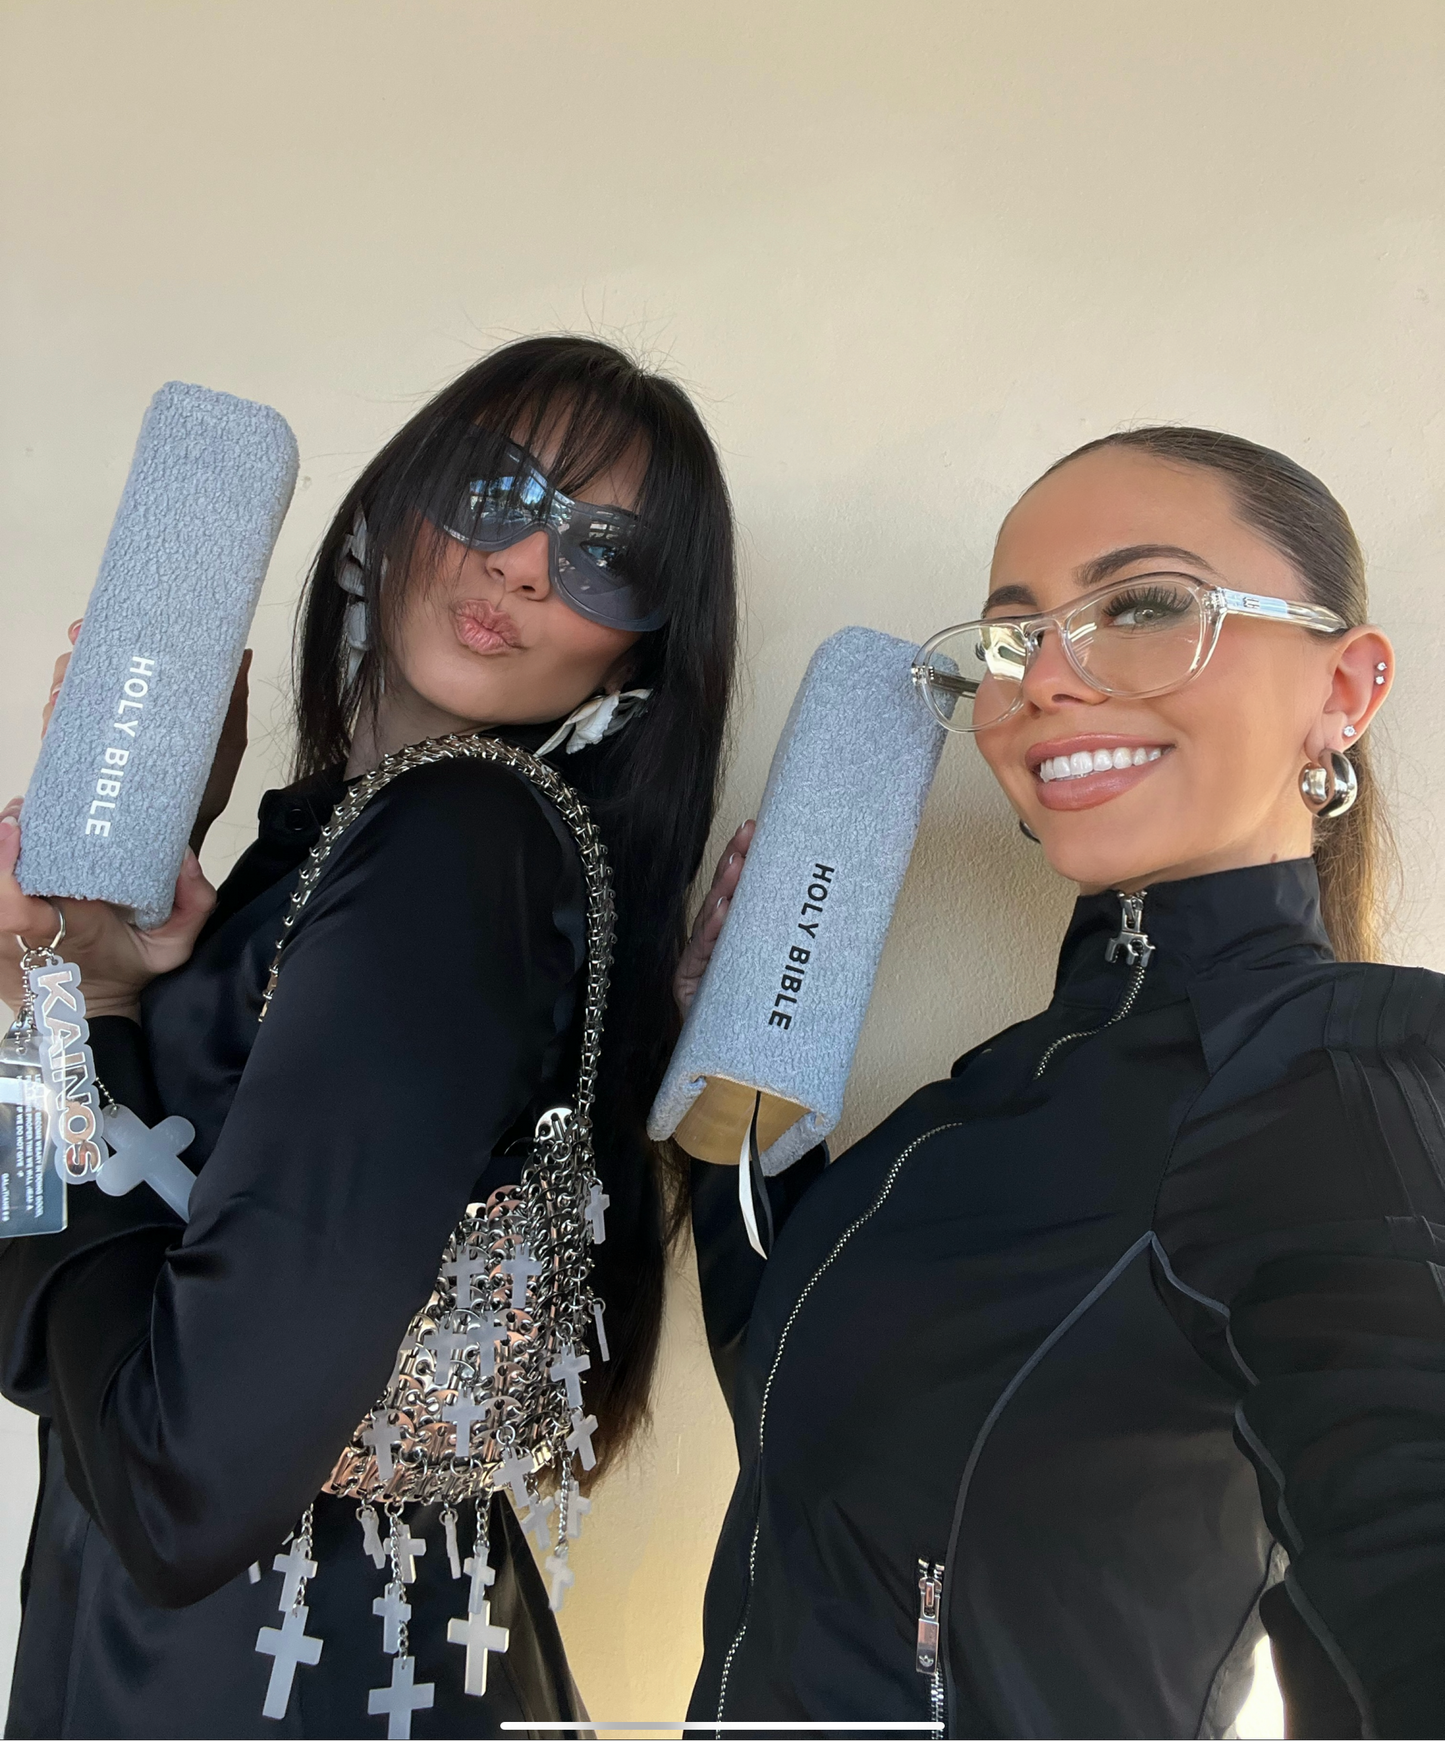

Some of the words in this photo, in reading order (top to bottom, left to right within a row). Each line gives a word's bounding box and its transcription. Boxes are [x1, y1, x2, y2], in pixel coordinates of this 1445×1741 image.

[113, 656, 155, 738] HOLY
[85, 747, 129, 837] BIBLE
[798, 863, 835, 939] HOLY
[768, 945, 811, 1030] BIBLE
[37, 970, 101, 1178] KAINOS
[16, 1113, 23, 1126] WE
[16, 1126, 23, 1135] DO
[16, 1151, 24, 1167] GIVE
[26, 1157, 33, 1168] WE
[35, 1140, 43, 1164] WEARY
